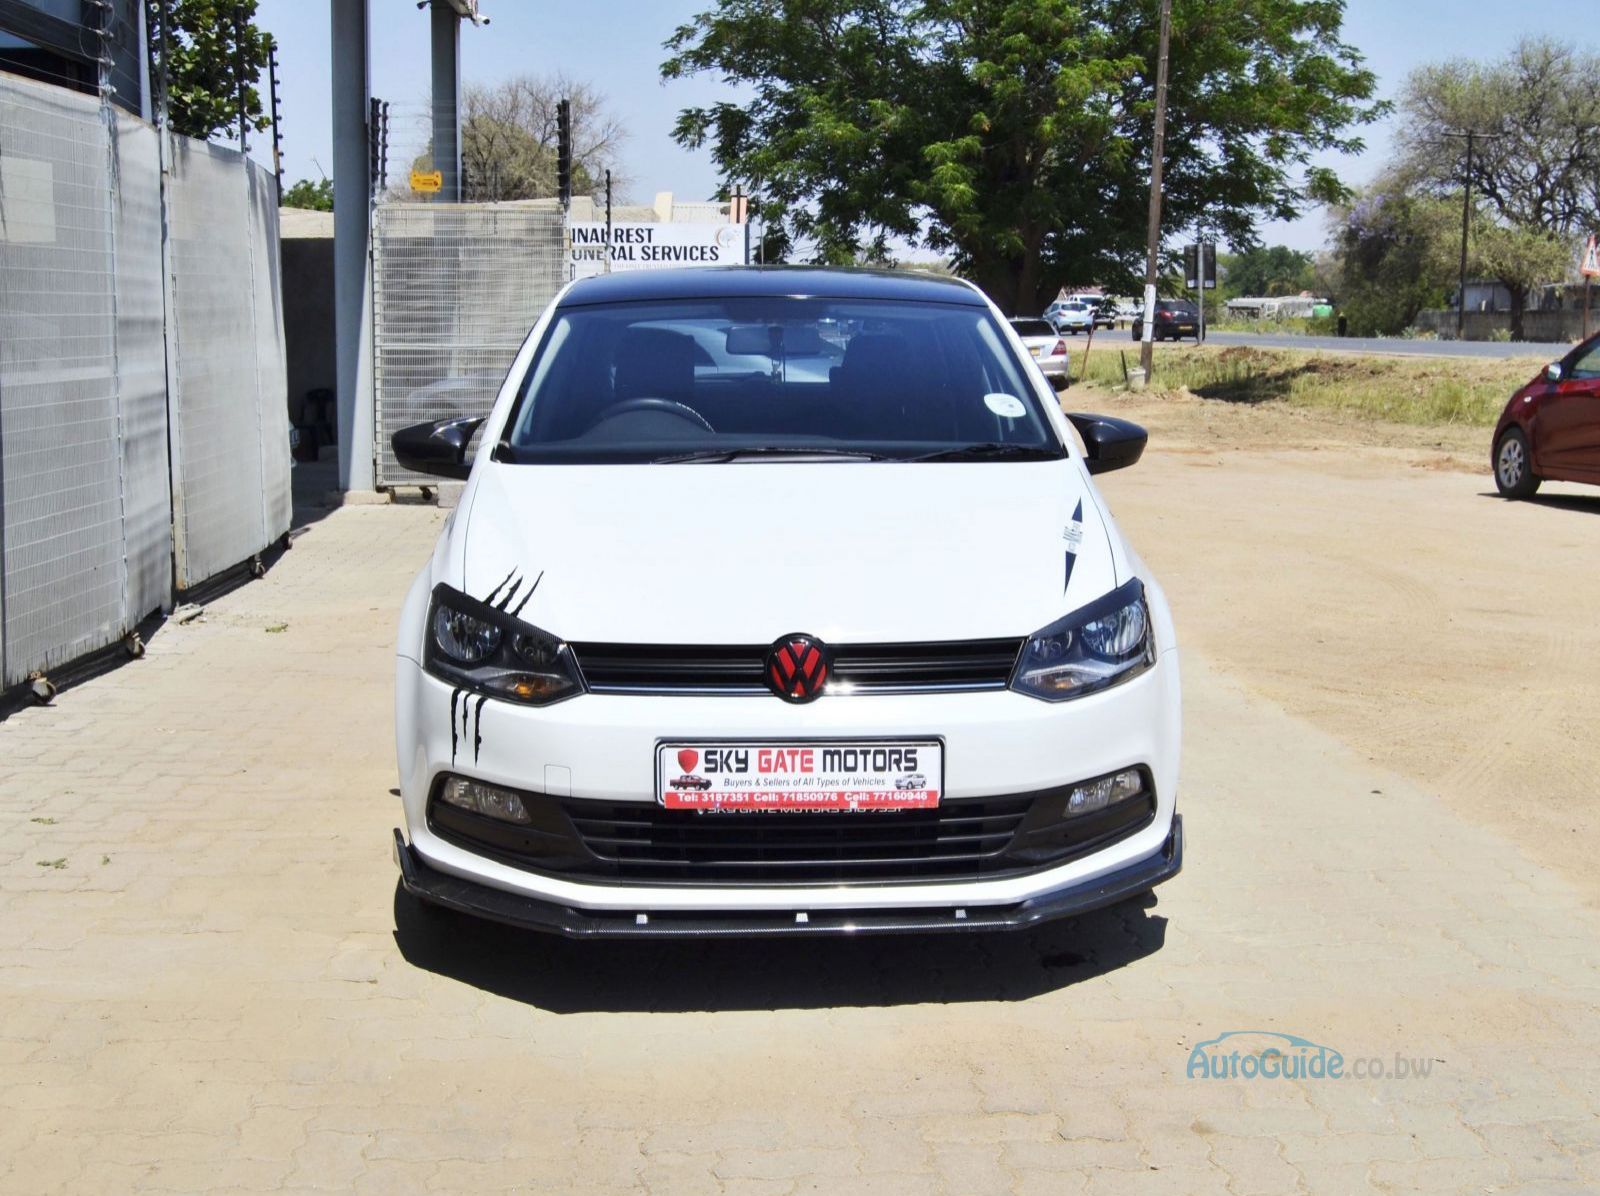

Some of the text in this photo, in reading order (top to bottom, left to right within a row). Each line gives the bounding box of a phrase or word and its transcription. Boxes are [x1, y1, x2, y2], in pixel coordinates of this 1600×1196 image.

[572, 228, 654, 243] INAL REST
[572, 245, 719, 261] UNERAL SERVICES
[704, 749, 918, 773] SKY GATE MOTORS
[723, 776, 886, 789] Buyers & Sellers of All Types of Vehicles
[677, 793, 698, 802] Tel:
[701, 792, 750, 802] 3187351
[753, 792, 779, 802] Cell:
[782, 792, 838, 802] 71850976
[844, 792, 870, 801] Cell:
